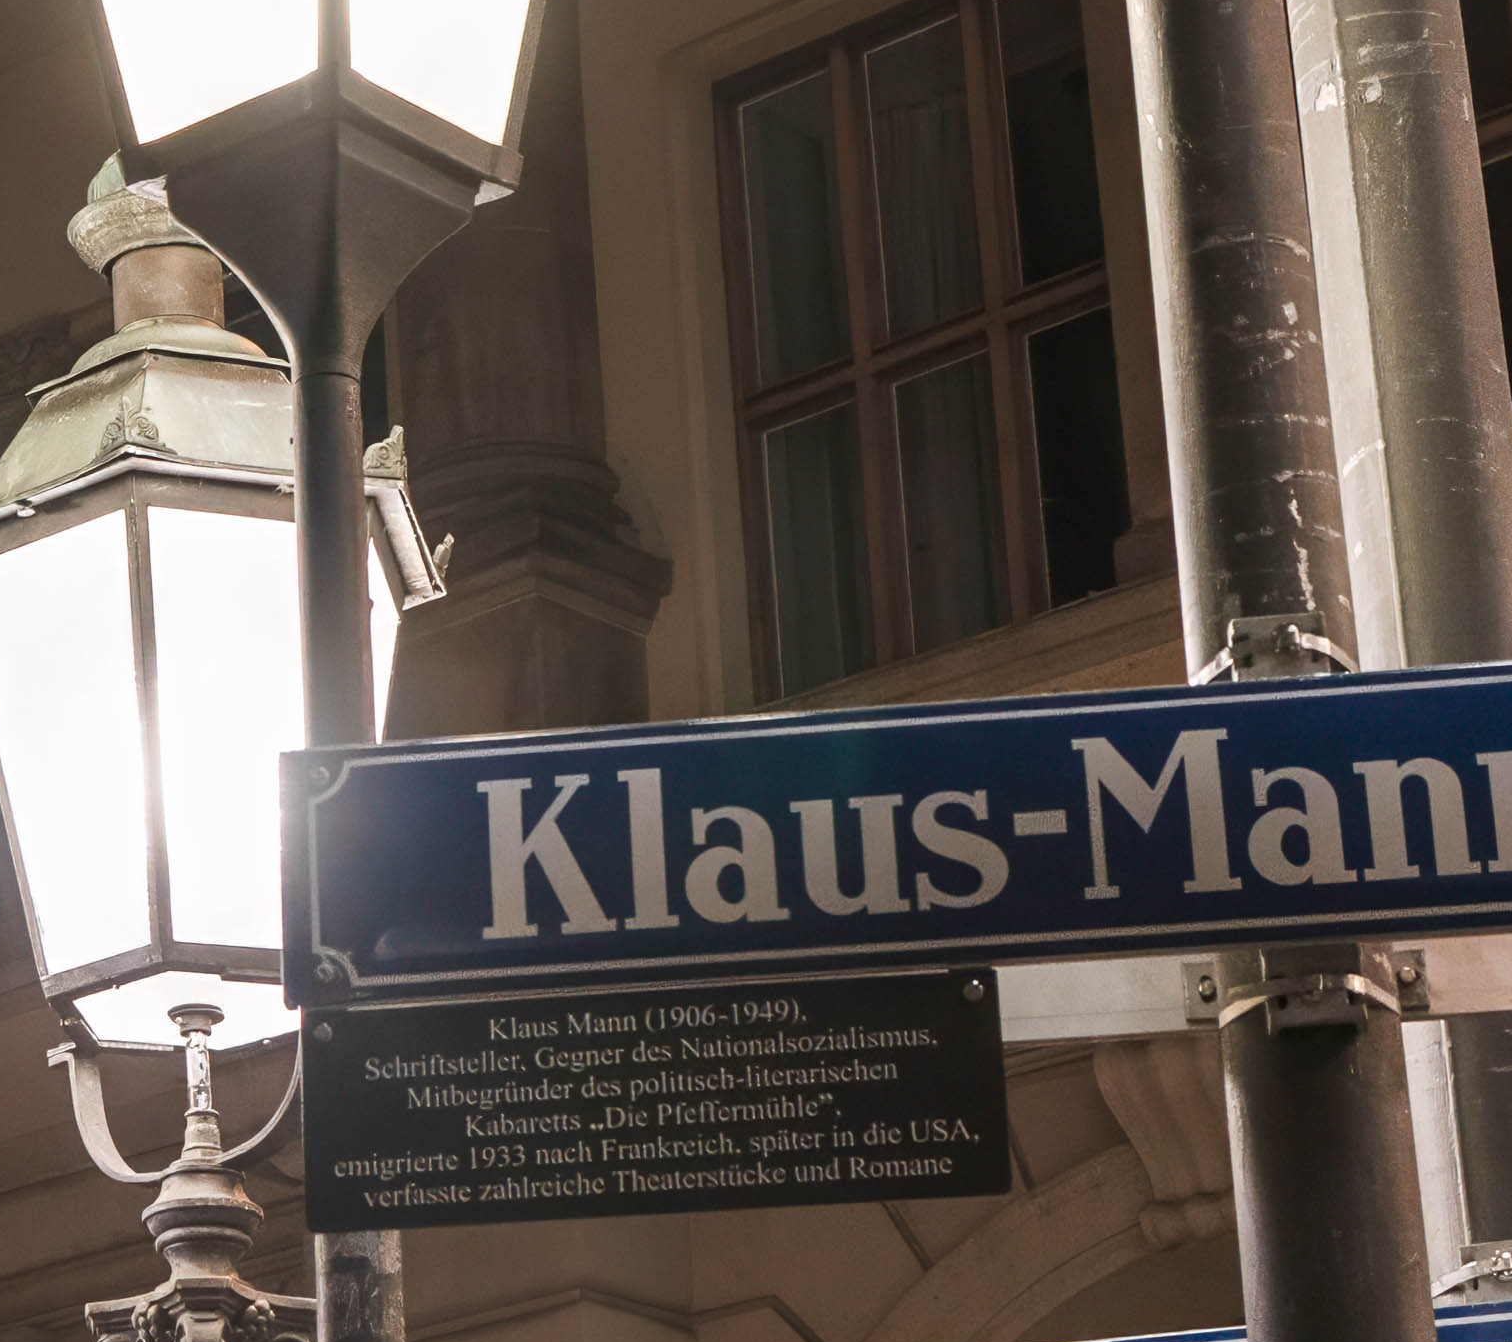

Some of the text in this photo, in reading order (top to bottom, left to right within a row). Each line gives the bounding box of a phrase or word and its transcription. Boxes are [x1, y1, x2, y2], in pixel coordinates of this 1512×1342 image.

[488, 1016, 560, 1041] Klaus
[567, 1011, 638, 1035] Mann
[533, 1046, 625, 1073] Gegner
[631, 1039, 673, 1063] des
[407, 1058, 899, 1111] Mitbegründer des politisch-literarischen
[465, 1112, 582, 1138] Kabaretts
[333, 1150, 459, 1182] emigrierte
[470, 1143, 526, 1170] 1933
[535, 1139, 593, 1166] nach
[748, 1128, 826, 1159] später
[831, 1124, 855, 1148] in
[862, 1121, 902, 1146] die
[363, 1156, 953, 1208] verfasste zahlreiche Theaterstücke und Romane
